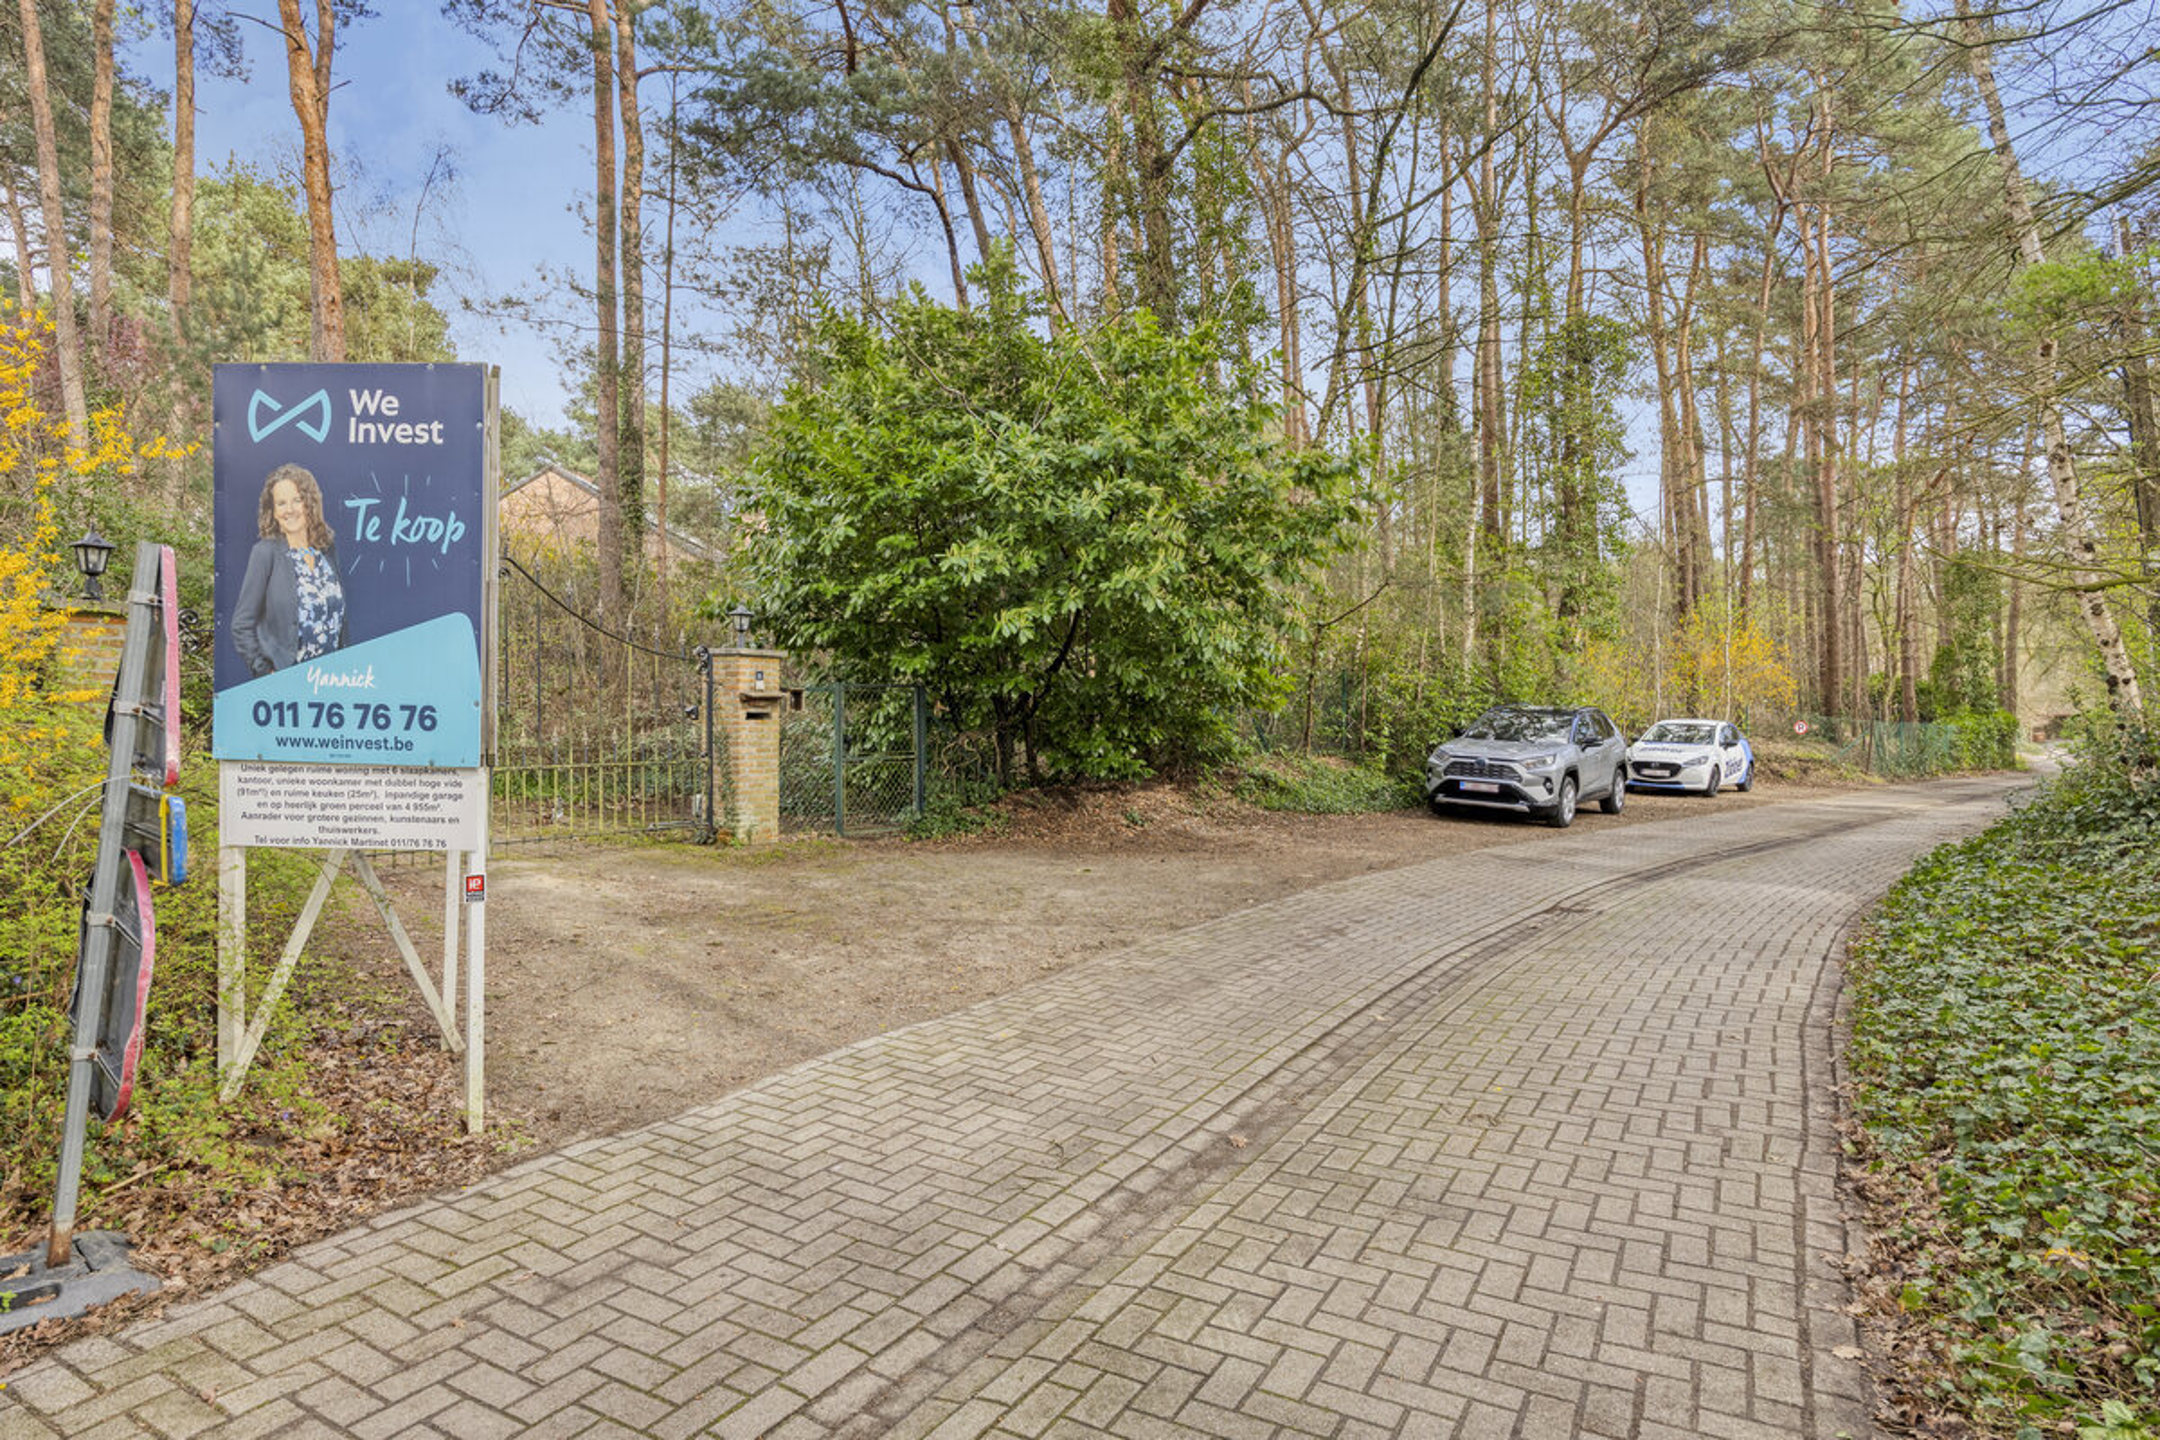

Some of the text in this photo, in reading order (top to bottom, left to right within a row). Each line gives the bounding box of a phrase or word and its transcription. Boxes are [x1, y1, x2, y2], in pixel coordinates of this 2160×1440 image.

[349, 388, 399, 416] We
[348, 417, 444, 444] Invest
[344, 497, 465, 555] Te koop
[307, 665, 375, 694] Yannick
[252, 700, 438, 732] 011 76 76 76
[275, 734, 414, 752] www.weinvest.be
[241, 764, 266, 773] Uniek
[268, 764, 305, 775] gelegen
[306, 765, 333, 774] ruime
[276, 776, 307, 785] unieke
[309, 777, 362, 787] woonkamer
[365, 778, 382, 786] met
[385, 778, 417, 787] dubbel
[418, 779, 441, 789] hoge
[444, 780, 463, 788] vide
[270, 789, 281, 797] en
[284, 788, 310, 797] ruime
[312, 788, 345, 798] keuken
[432, 792, 463, 802] garage
[257, 801, 268, 809] en
[270, 801, 282, 810] op
[284, 800, 317, 811] heerlijk
[320, 802, 346, 811] groen
[349, 802, 384, 812] perceel
[385, 803, 403, 811] van
[241, 811, 281, 820] Aanrader
[307, 813, 340, 823] grotere
[342, 814, 387, 824] gezinnen,
[390, 814, 446, 824] kunstenaars
[448, 816, 460, 824] en
[318, 825, 381, 835] thuiswerkers.
[255, 835, 447, 848] Tel voor info Yannick Martinet 011/76 76 76
